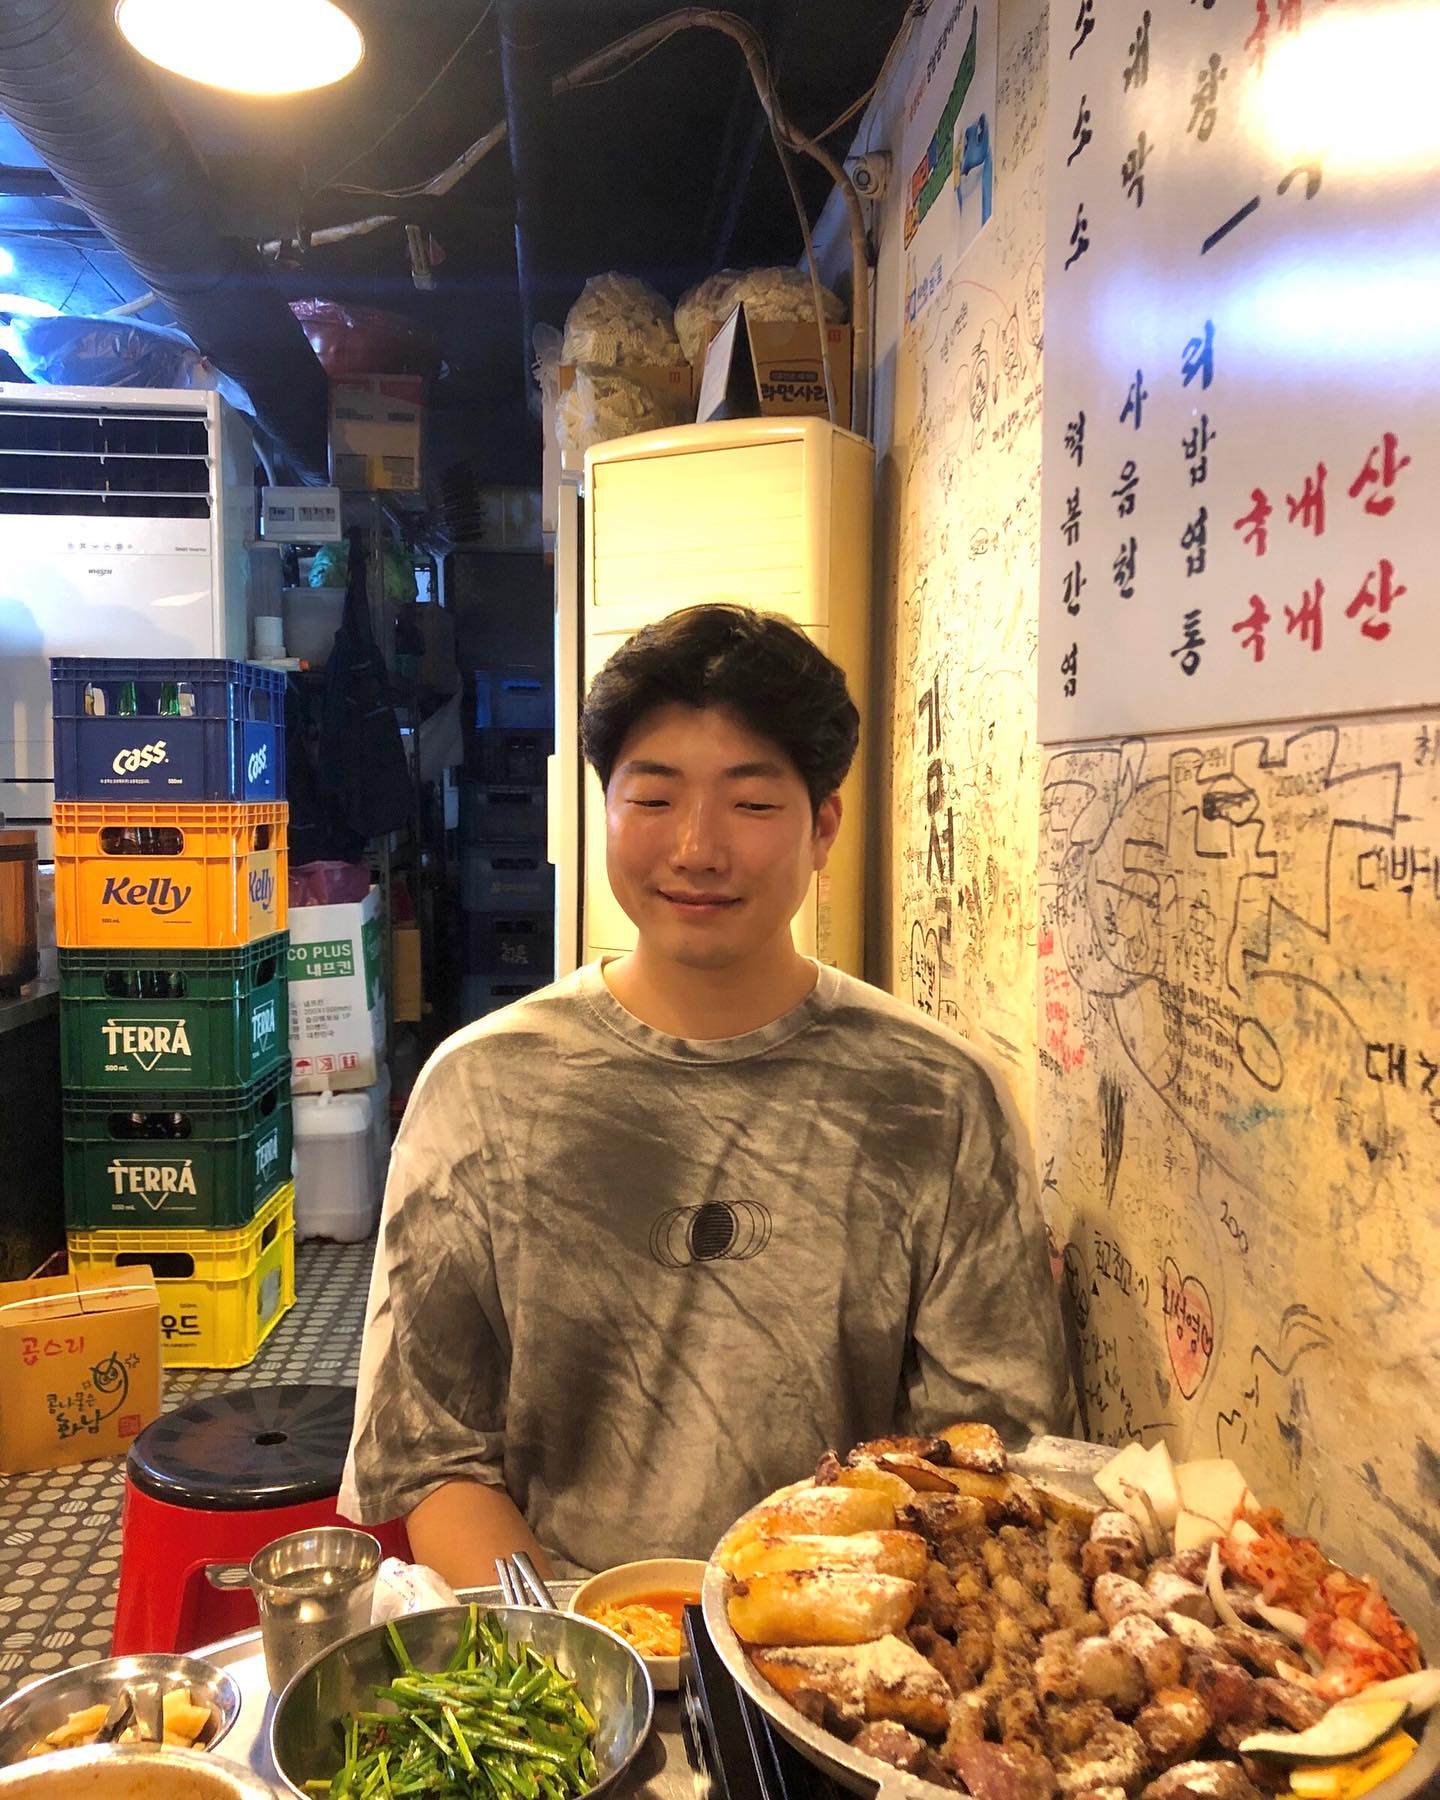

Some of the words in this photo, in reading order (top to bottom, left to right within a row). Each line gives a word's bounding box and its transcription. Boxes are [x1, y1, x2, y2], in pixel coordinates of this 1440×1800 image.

[1233, 431, 1412, 557] 국내산
[1232, 558, 1408, 664] 국내산
[101, 876, 193, 915] Kelly
[248, 867, 276, 912] Kelly
[313, 943, 352, 959] PLUS
[101, 1023, 192, 1057] TERRA
[251, 1004, 276, 1042] TERRA
[107, 1164, 198, 1196] TERRA
[21, 1335, 85, 1366] 곱스리
